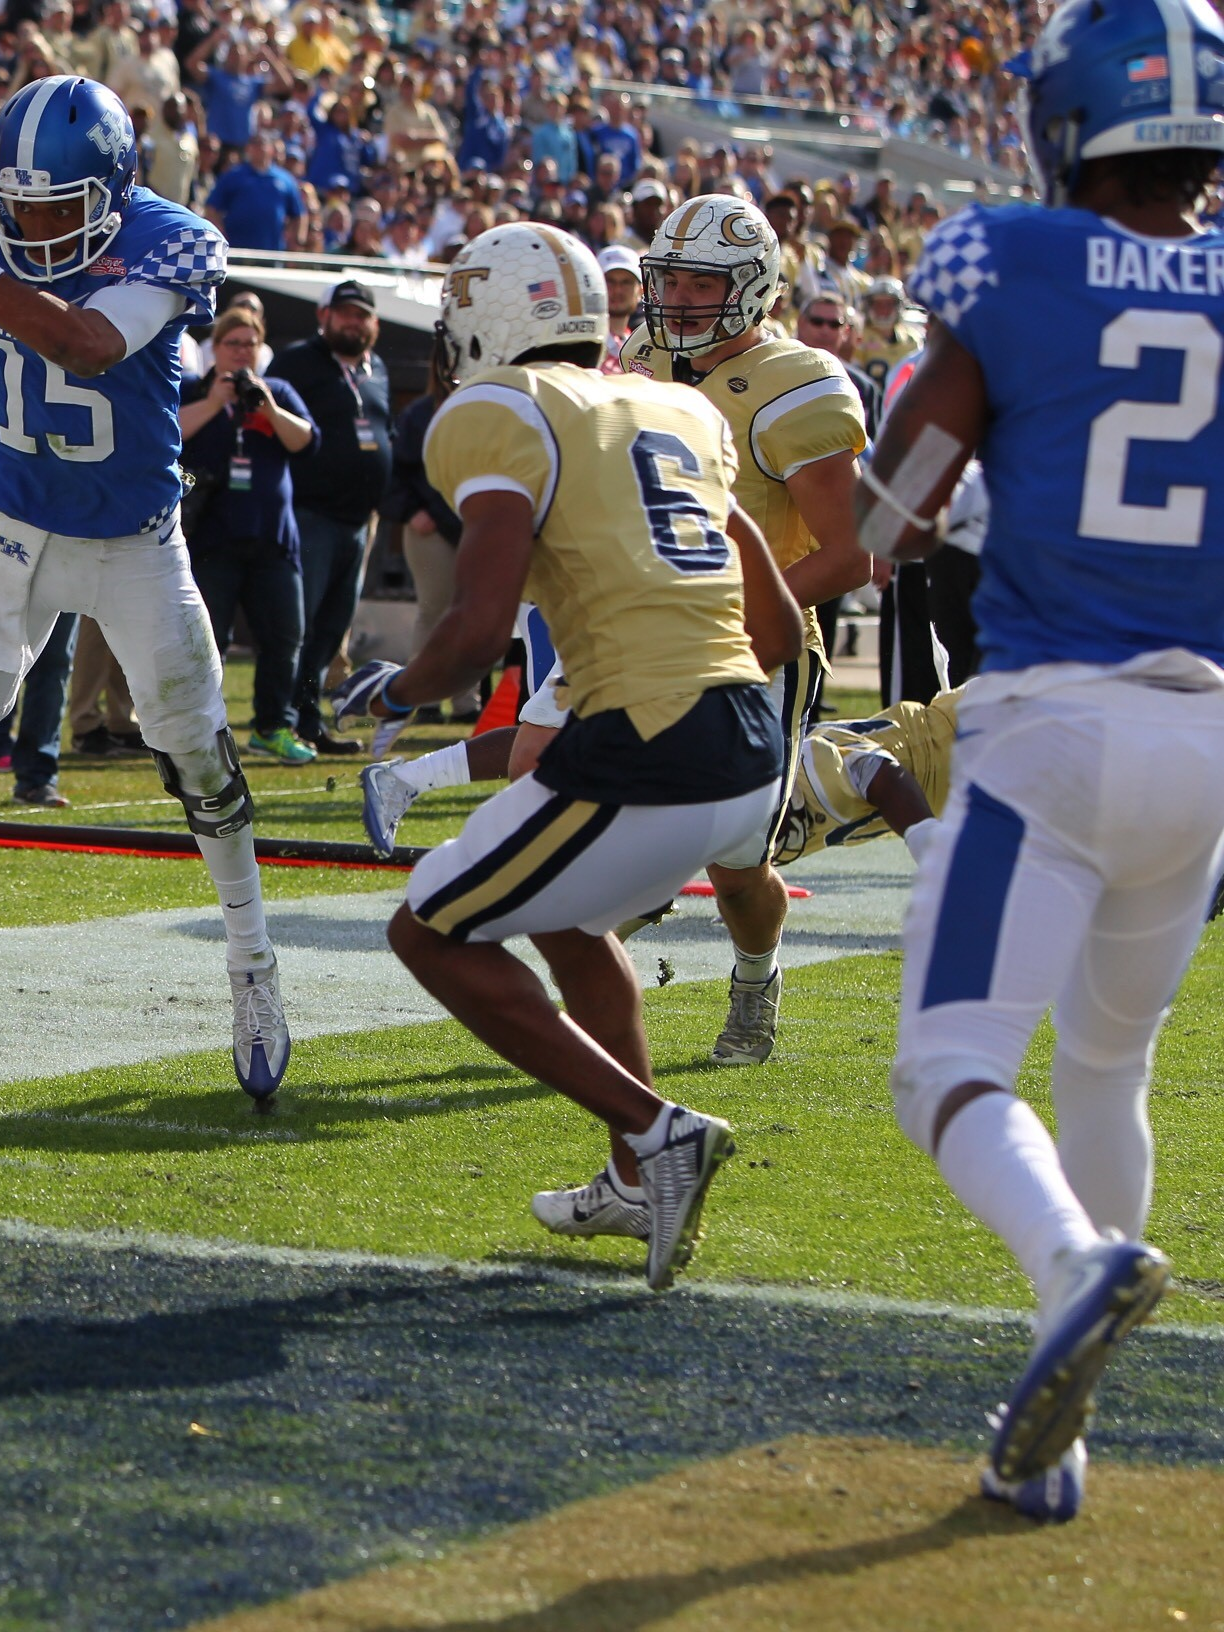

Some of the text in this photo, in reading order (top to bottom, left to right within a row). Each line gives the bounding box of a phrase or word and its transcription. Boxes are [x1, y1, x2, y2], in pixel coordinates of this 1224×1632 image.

[1086, 236, 1224, 296] BAKER
[556, 320, 596, 336] JACKETS
[637, 344, 654, 357] R
[1077, 308, 1223, 547] 2
[627, 428, 732, 576] 6
